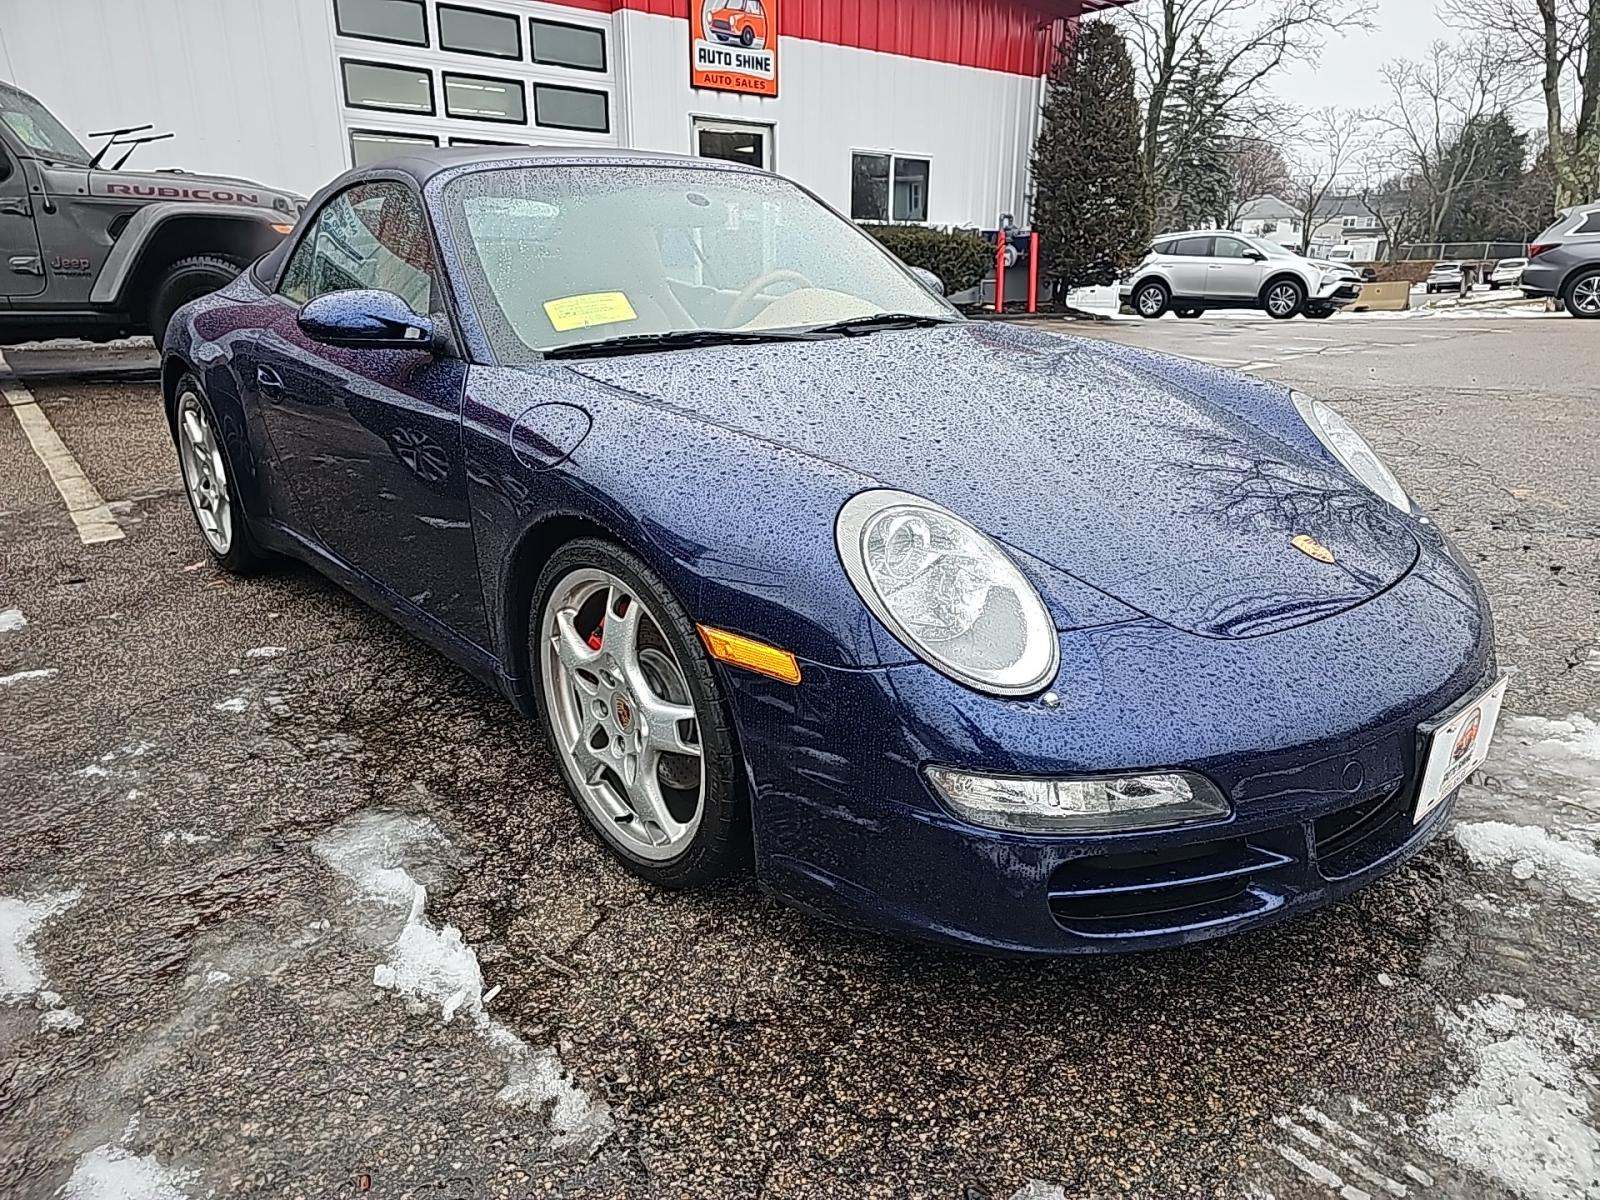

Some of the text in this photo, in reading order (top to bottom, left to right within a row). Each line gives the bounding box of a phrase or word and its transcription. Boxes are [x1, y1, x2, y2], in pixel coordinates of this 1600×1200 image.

[699, 48, 771, 72] AUTO SHINE
[704, 73, 766, 90] AUTO SALES
[106, 183, 258, 203] RUBICON
[51, 256, 90, 271] Jeep
